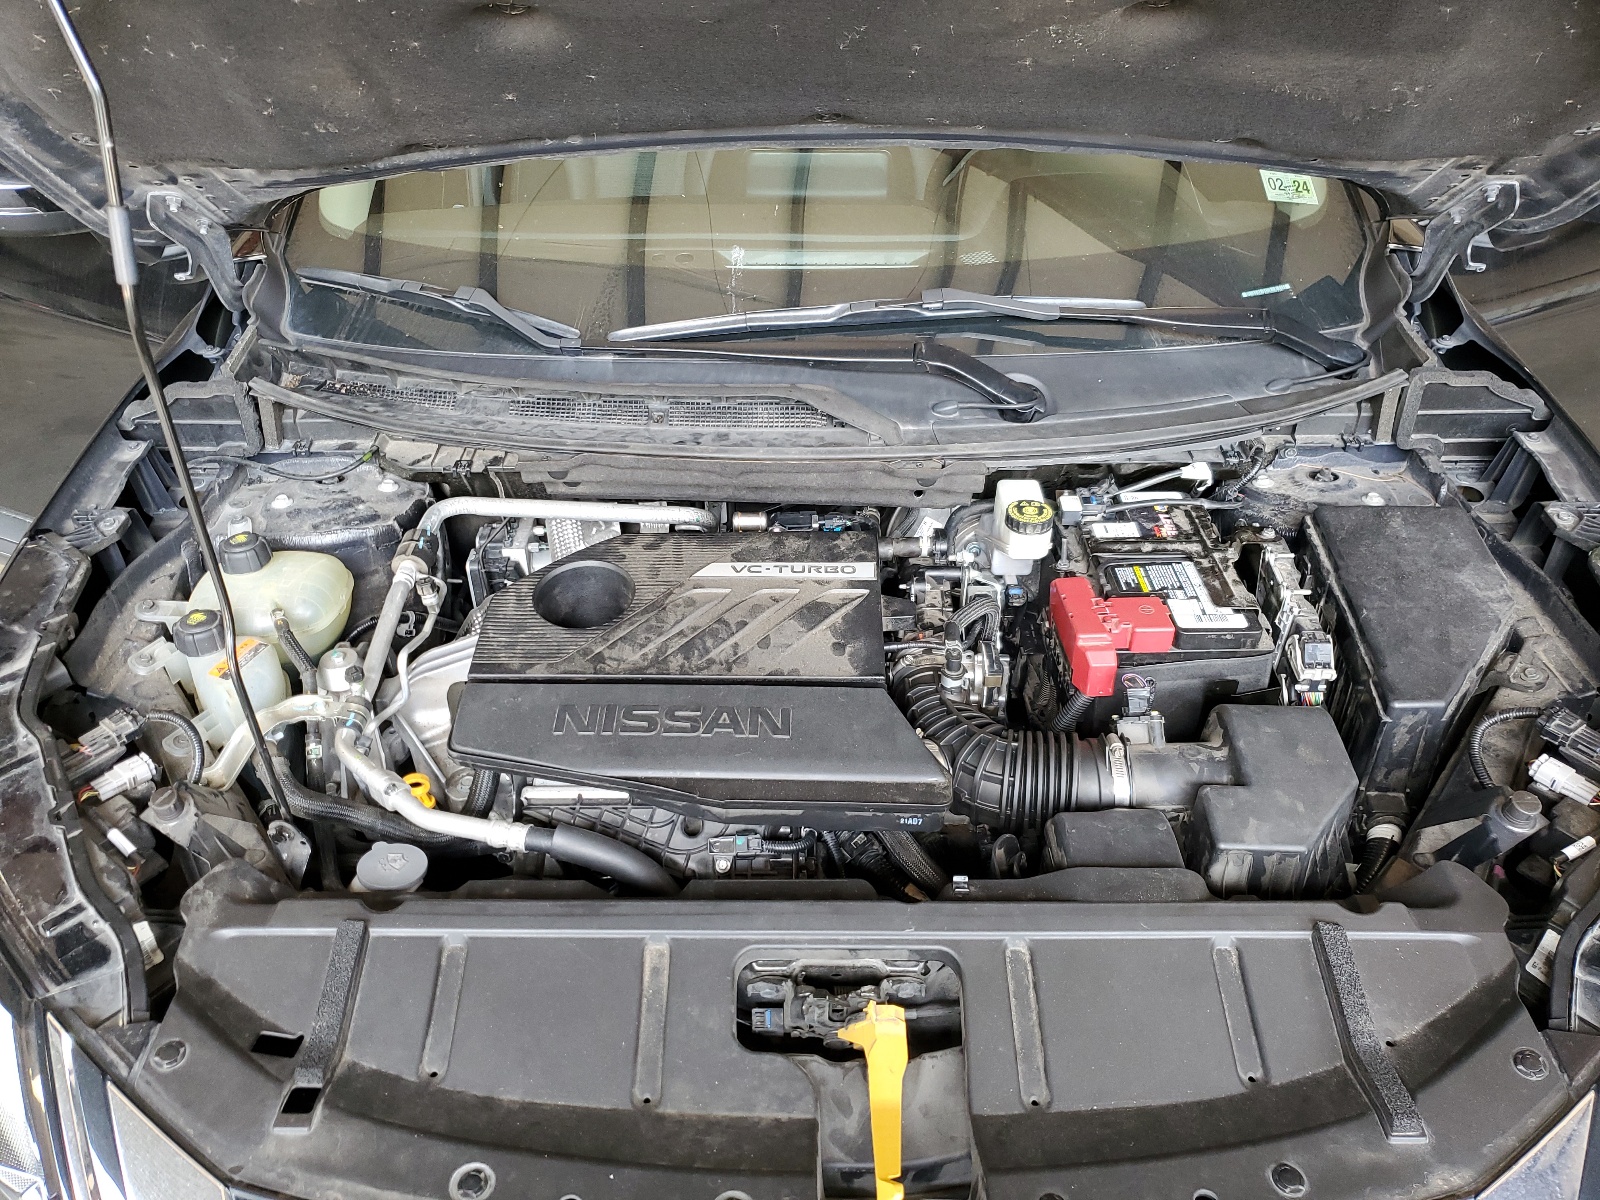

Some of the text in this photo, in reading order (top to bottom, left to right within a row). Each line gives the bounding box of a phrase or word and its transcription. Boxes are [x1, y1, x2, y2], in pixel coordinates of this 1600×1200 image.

[1268, 178, 1286, 191] 02
[1293, 180, 1310, 194] 24
[730, 564, 857, 575] VC-TURBO
[553, 703, 793, 738] NISSAN
